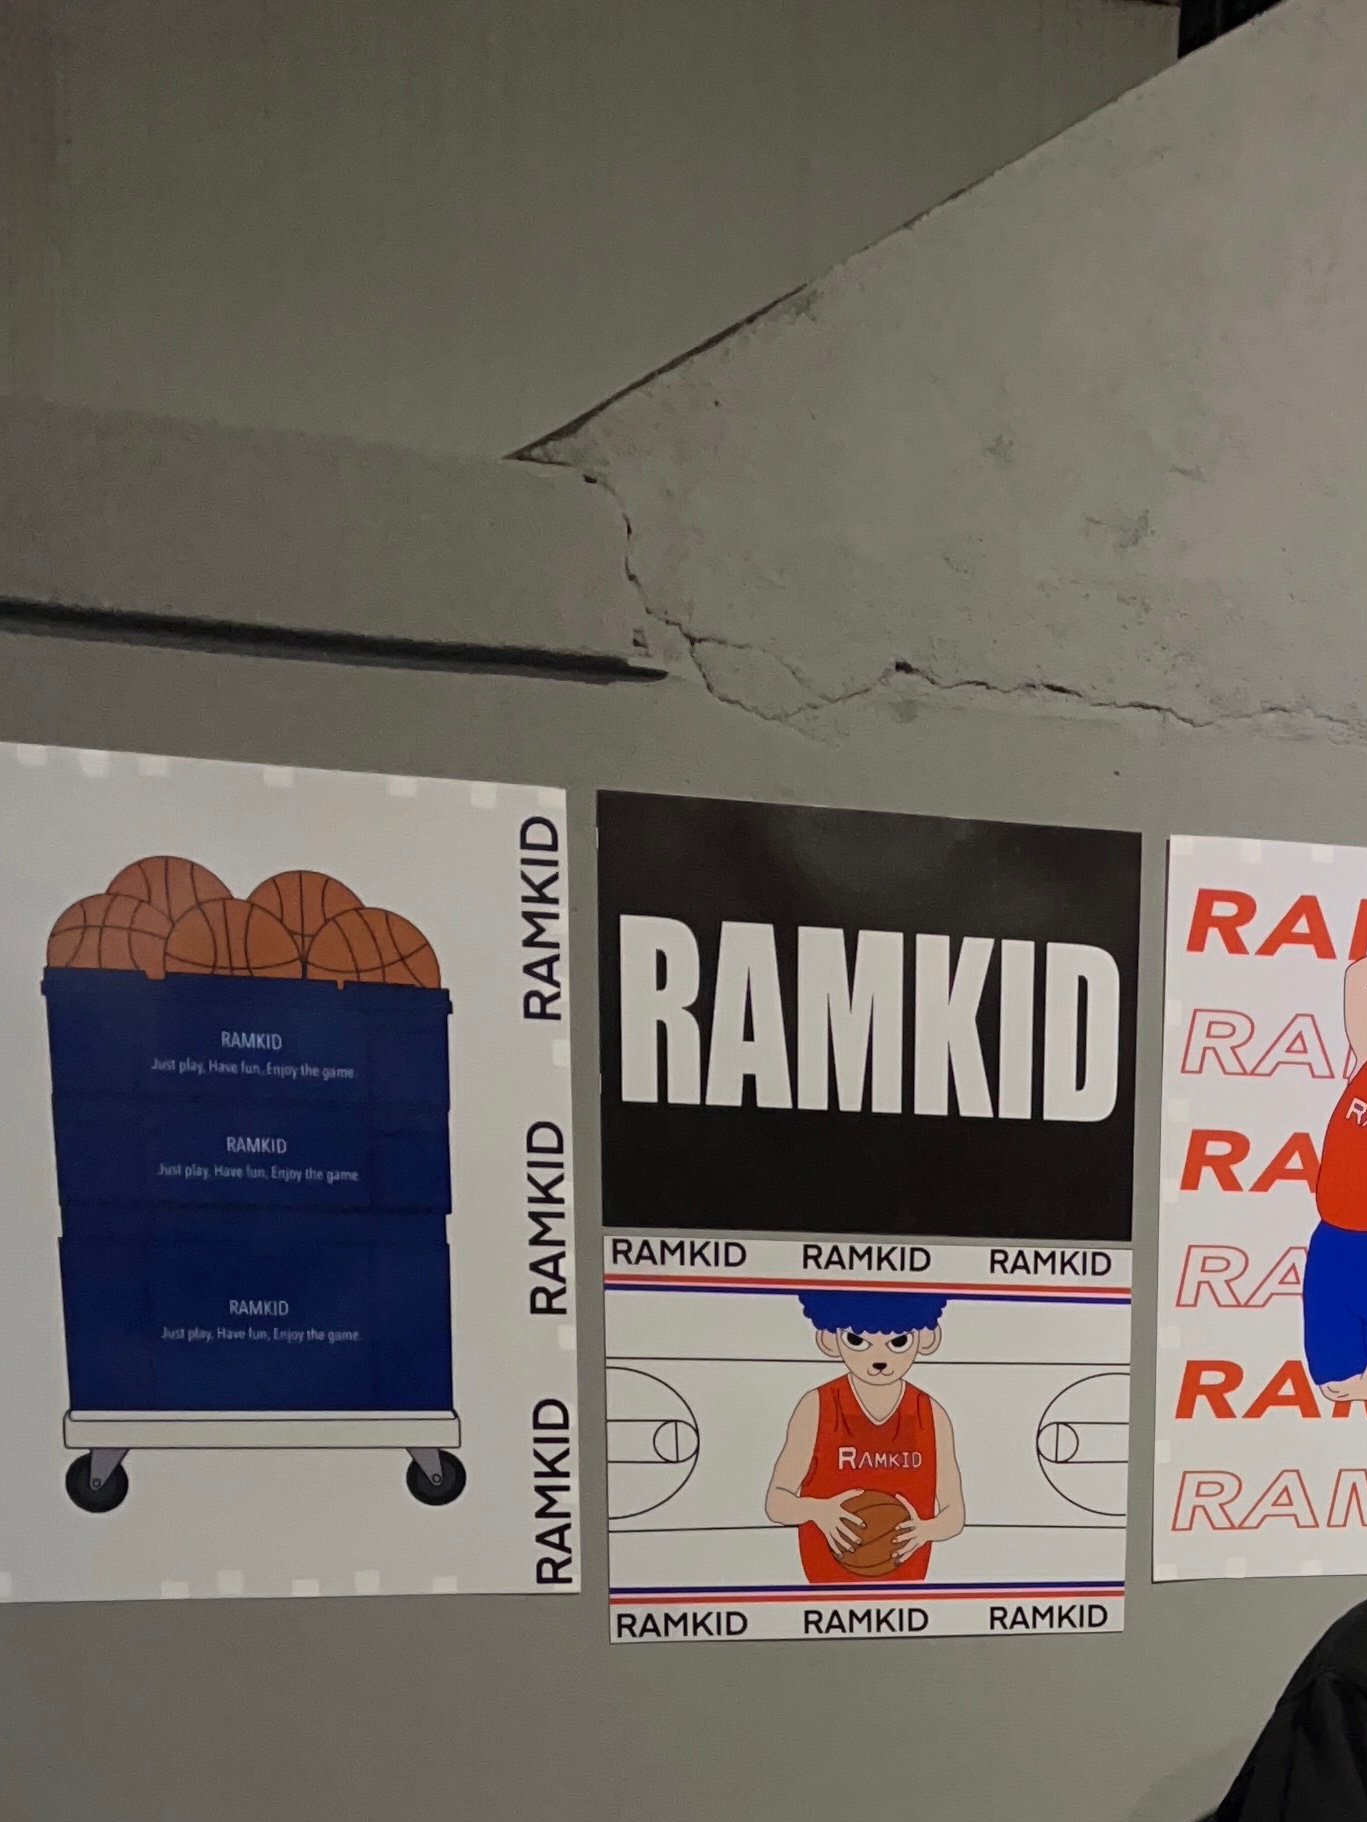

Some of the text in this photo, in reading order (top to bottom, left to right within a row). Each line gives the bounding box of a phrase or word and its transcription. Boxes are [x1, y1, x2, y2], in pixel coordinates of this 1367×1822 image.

[520, 814, 562, 1021] RAMKID
[618, 914, 1122, 1124] RAMKID
[221, 1030, 283, 1050] RAMKID
[226, 1136, 287, 1154] RAMKID
[525, 1119, 568, 1316] RAMKID
[611, 1237, 1114, 1278] RAMKID RAMKID RAMKID
[229, 1299, 289, 1316] RAMKID
[836, 1444, 924, 1473] RAMKID
[531, 1397, 574, 1588] RAMKID
[615, 1604, 1110, 1638] RAMKID RAMKID RAMKID
